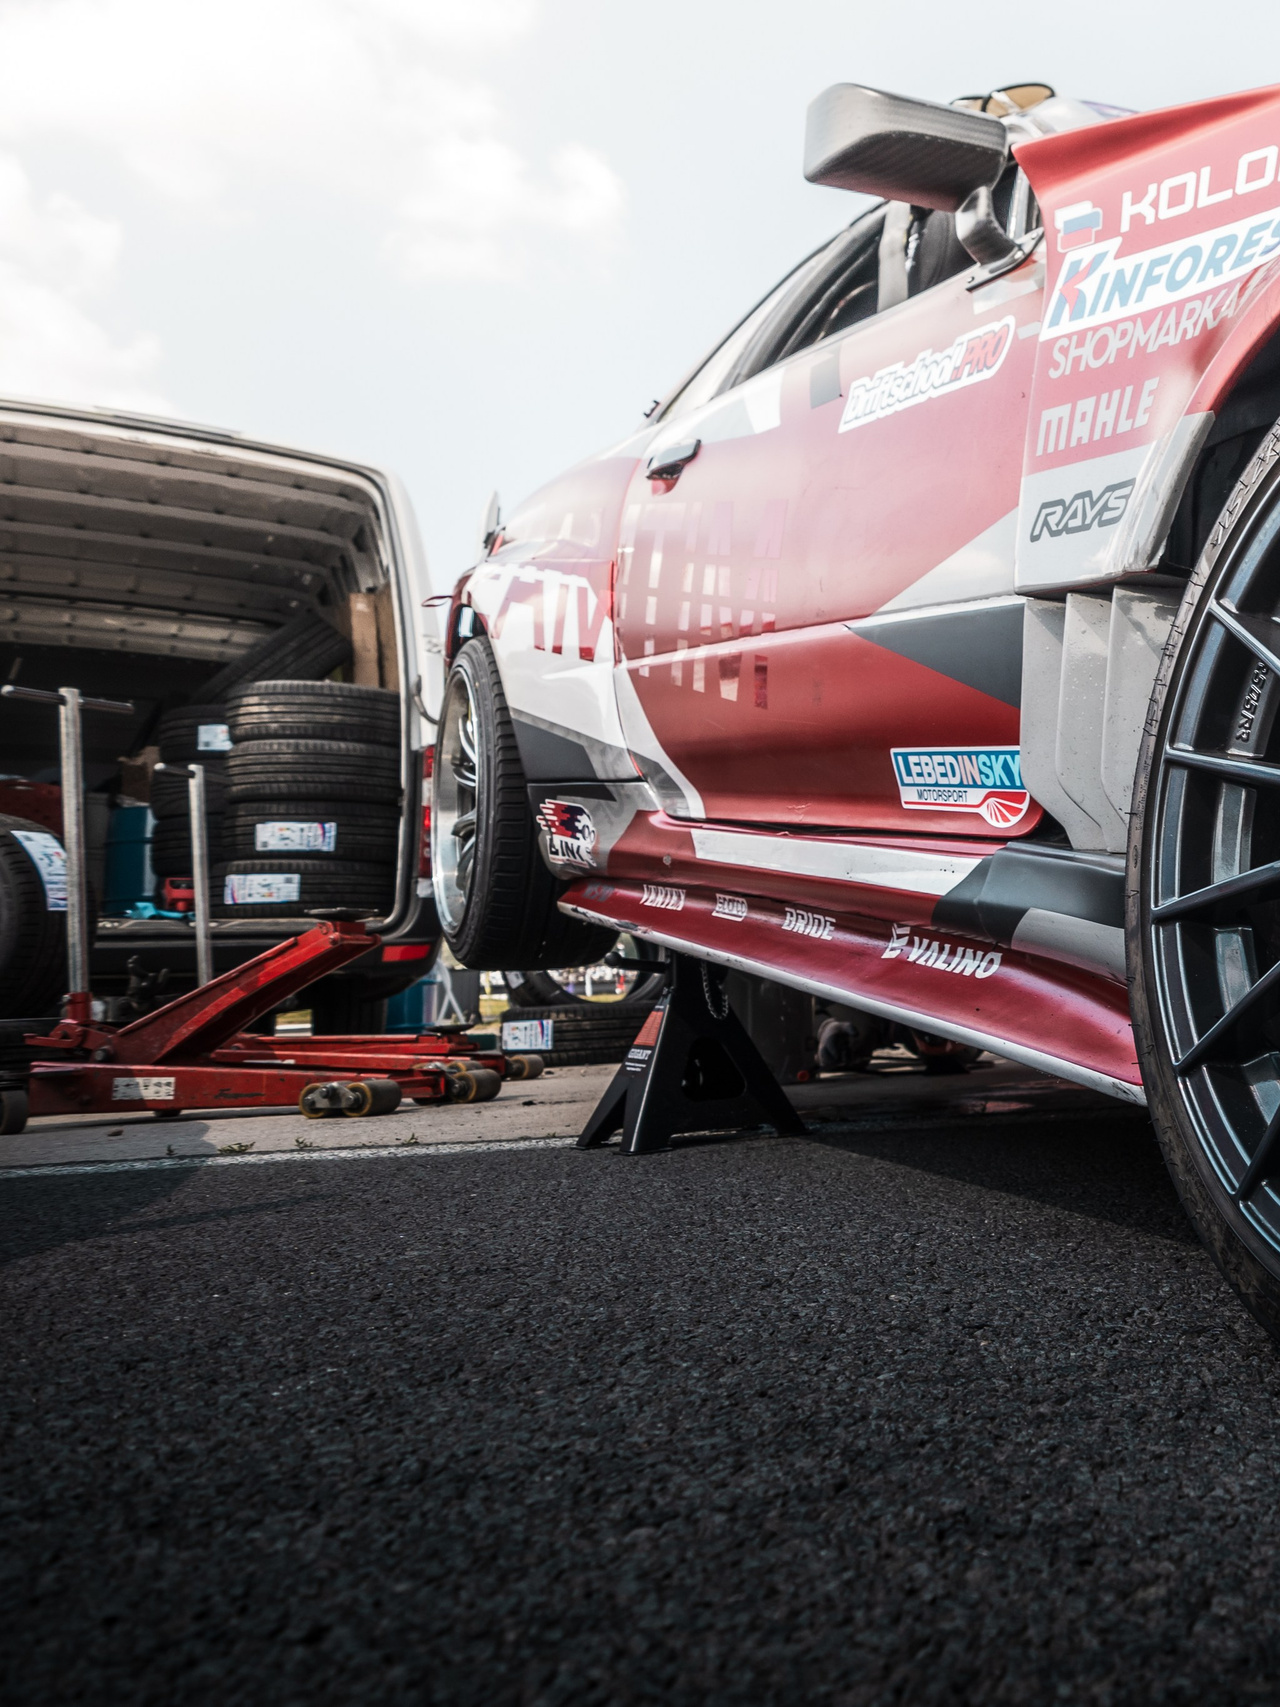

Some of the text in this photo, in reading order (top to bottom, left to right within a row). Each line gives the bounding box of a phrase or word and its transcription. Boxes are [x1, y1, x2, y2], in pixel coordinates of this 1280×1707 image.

[1036, 376, 1160, 457] MAHLE
[1030, 477, 1137, 543] RAYS
[896, 753, 1022, 787] LEBEDINSKY
[916, 788, 969, 803] MOTORSPORT
[781, 906, 837, 941] BRIDE
[906, 935, 1003, 980] VALINO
